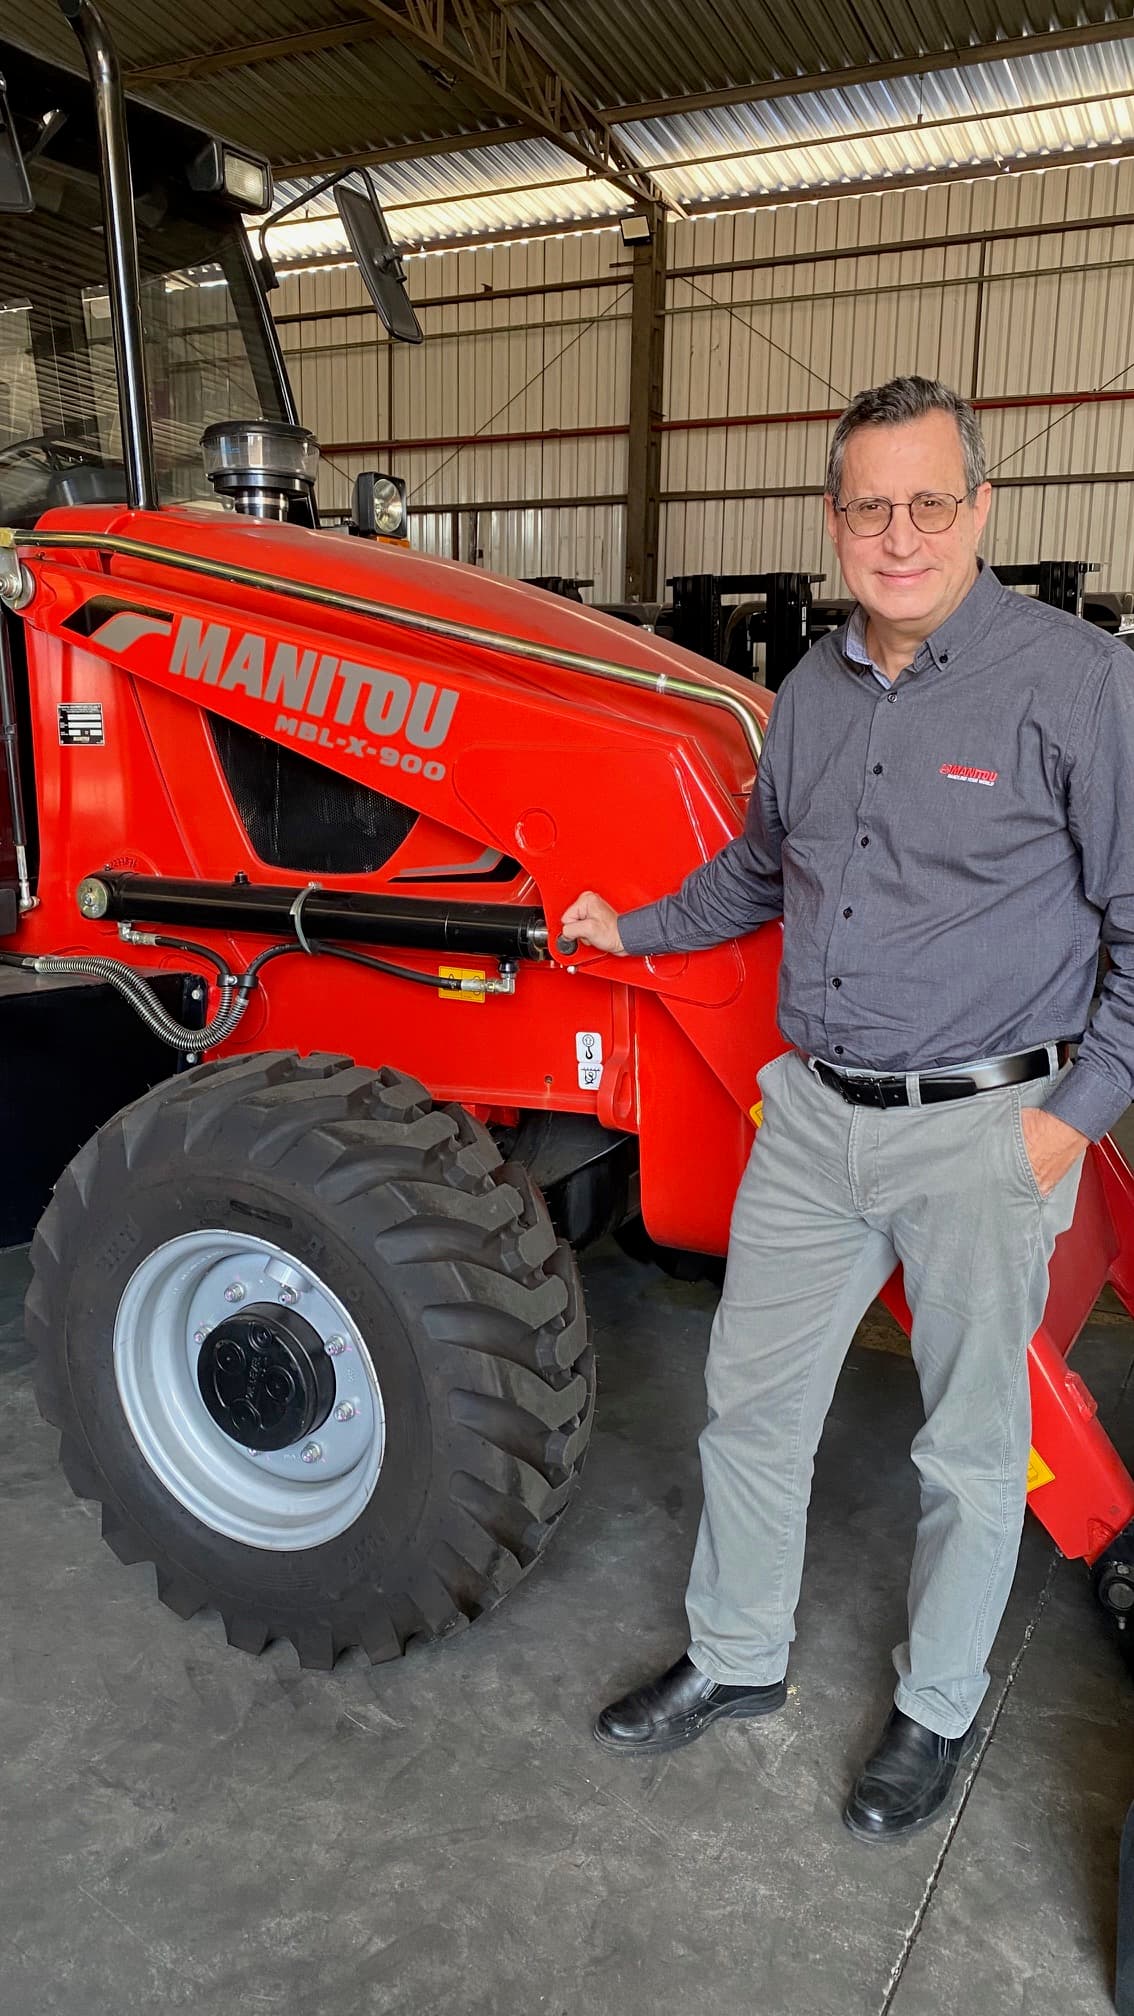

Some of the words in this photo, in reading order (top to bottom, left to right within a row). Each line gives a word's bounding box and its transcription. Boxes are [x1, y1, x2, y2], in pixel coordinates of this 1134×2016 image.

[168, 615, 460, 750] MANITOU
[273, 714, 447, 782] MBL-X-900
[950, 764, 998, 782] MANITOU
